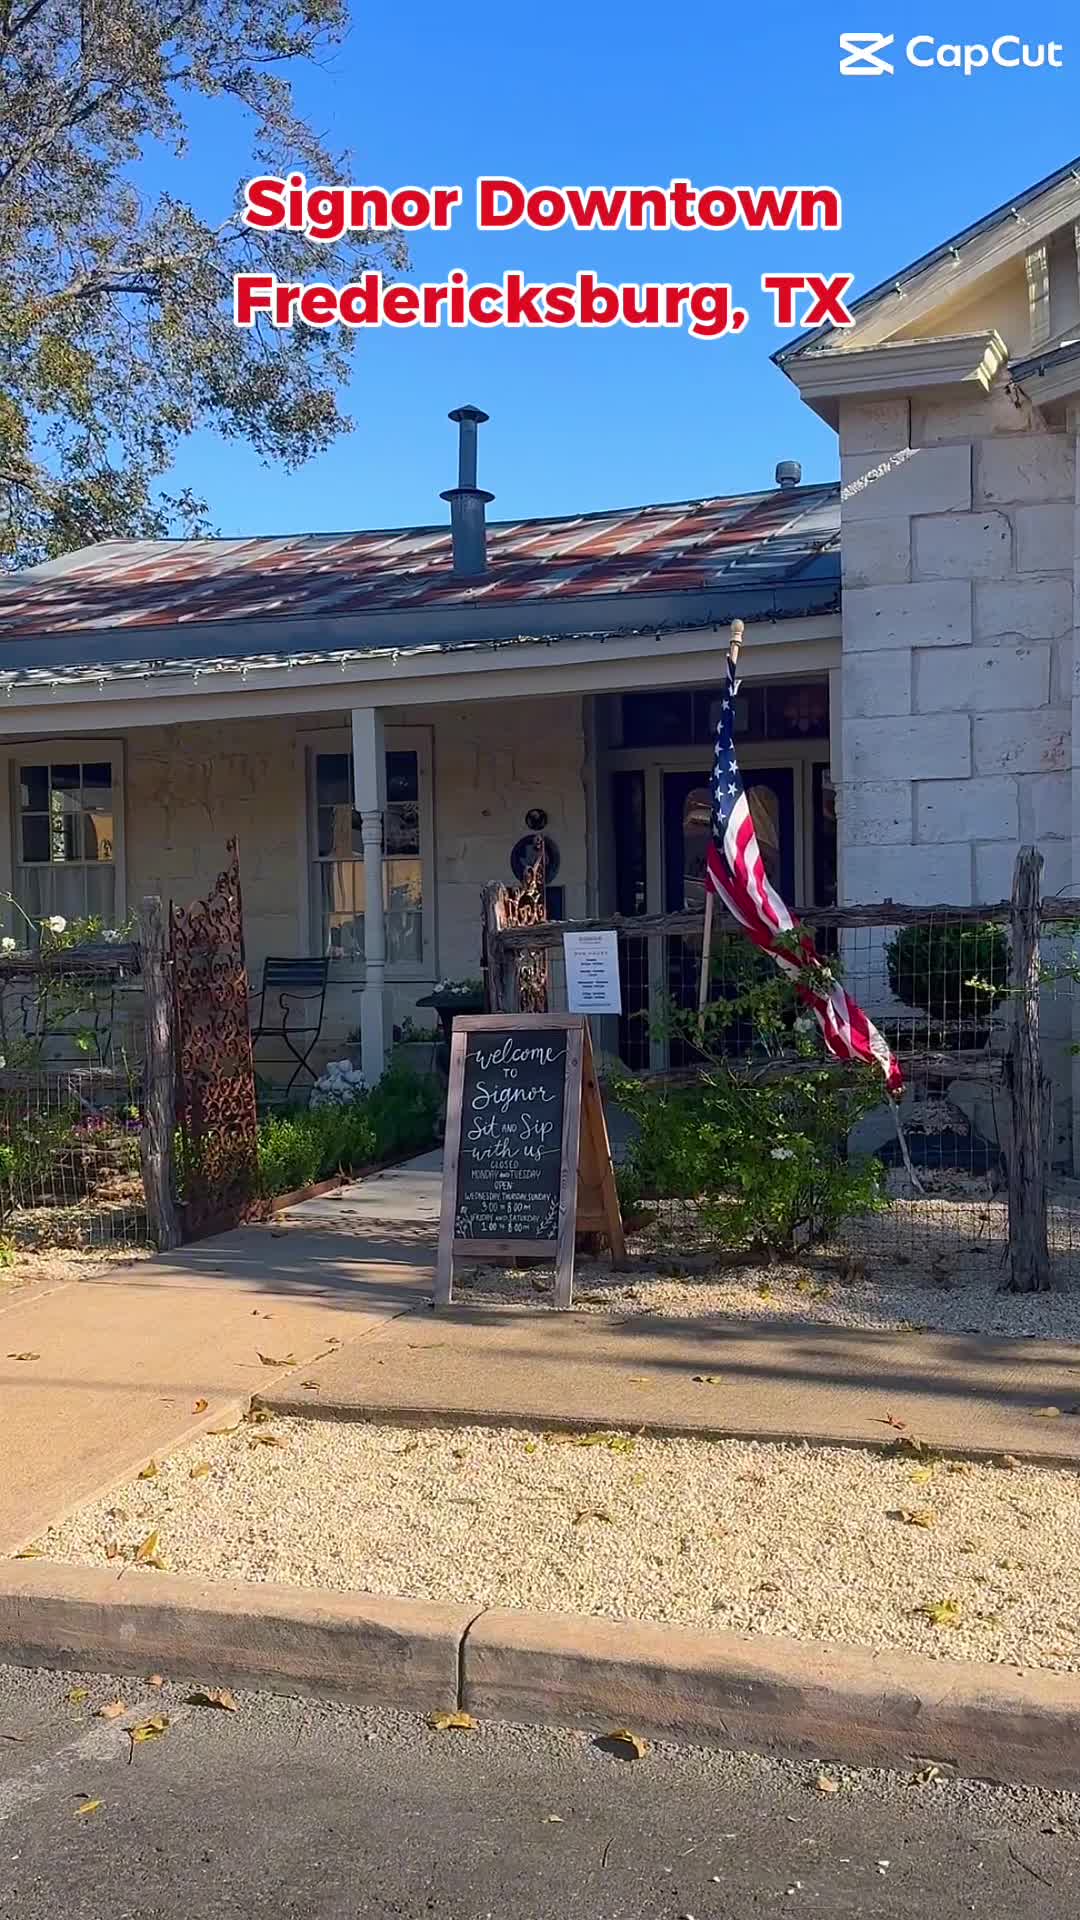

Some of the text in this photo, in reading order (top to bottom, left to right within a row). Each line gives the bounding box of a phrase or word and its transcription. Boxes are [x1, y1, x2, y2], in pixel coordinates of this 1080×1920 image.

[468, 1038, 565, 1069] welcome
[503, 1068, 518, 1078] TO
[472, 1081, 555, 1112] Signor
[467, 1113, 553, 1142] Sit AND Sip
[470, 1137, 547, 1161] with us
[490, 1160, 519, 1169] CLOSED
[471, 1169, 499, 1179] MONDAY
[510, 1169, 543, 1179] TUESDAY
[494, 1180, 512, 1190] OPEN
[480, 1201, 498, 1213] 300
[507, 1201, 523, 1213] 800
[480, 1221, 498, 1232] 100
[507, 1222, 523, 1233] 800
